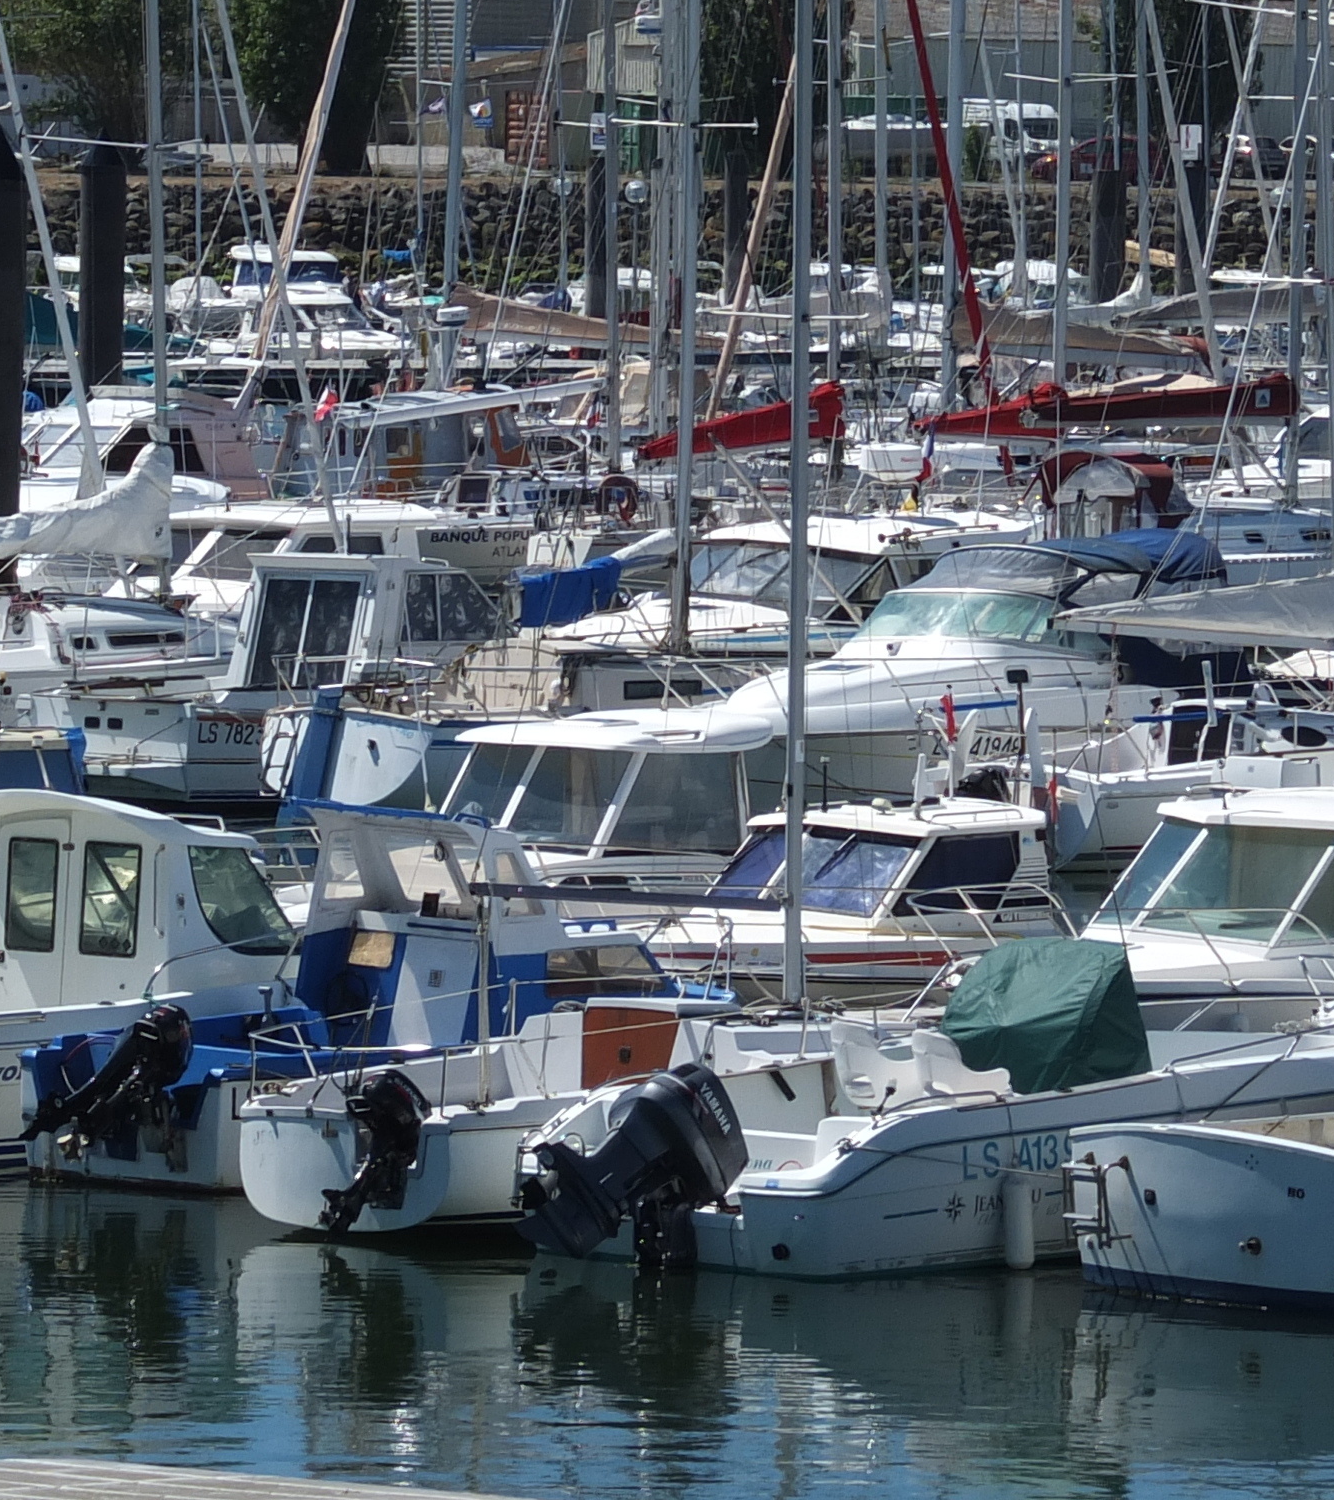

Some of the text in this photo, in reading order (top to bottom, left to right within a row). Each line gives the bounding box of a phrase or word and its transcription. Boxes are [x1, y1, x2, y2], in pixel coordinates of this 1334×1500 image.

[430, 531, 533, 543] BANQUE POPU
[197, 723, 217, 744] LS
[699, 1082, 732, 1137] YAMAHA
[962, 1141, 1001, 1181] LS
